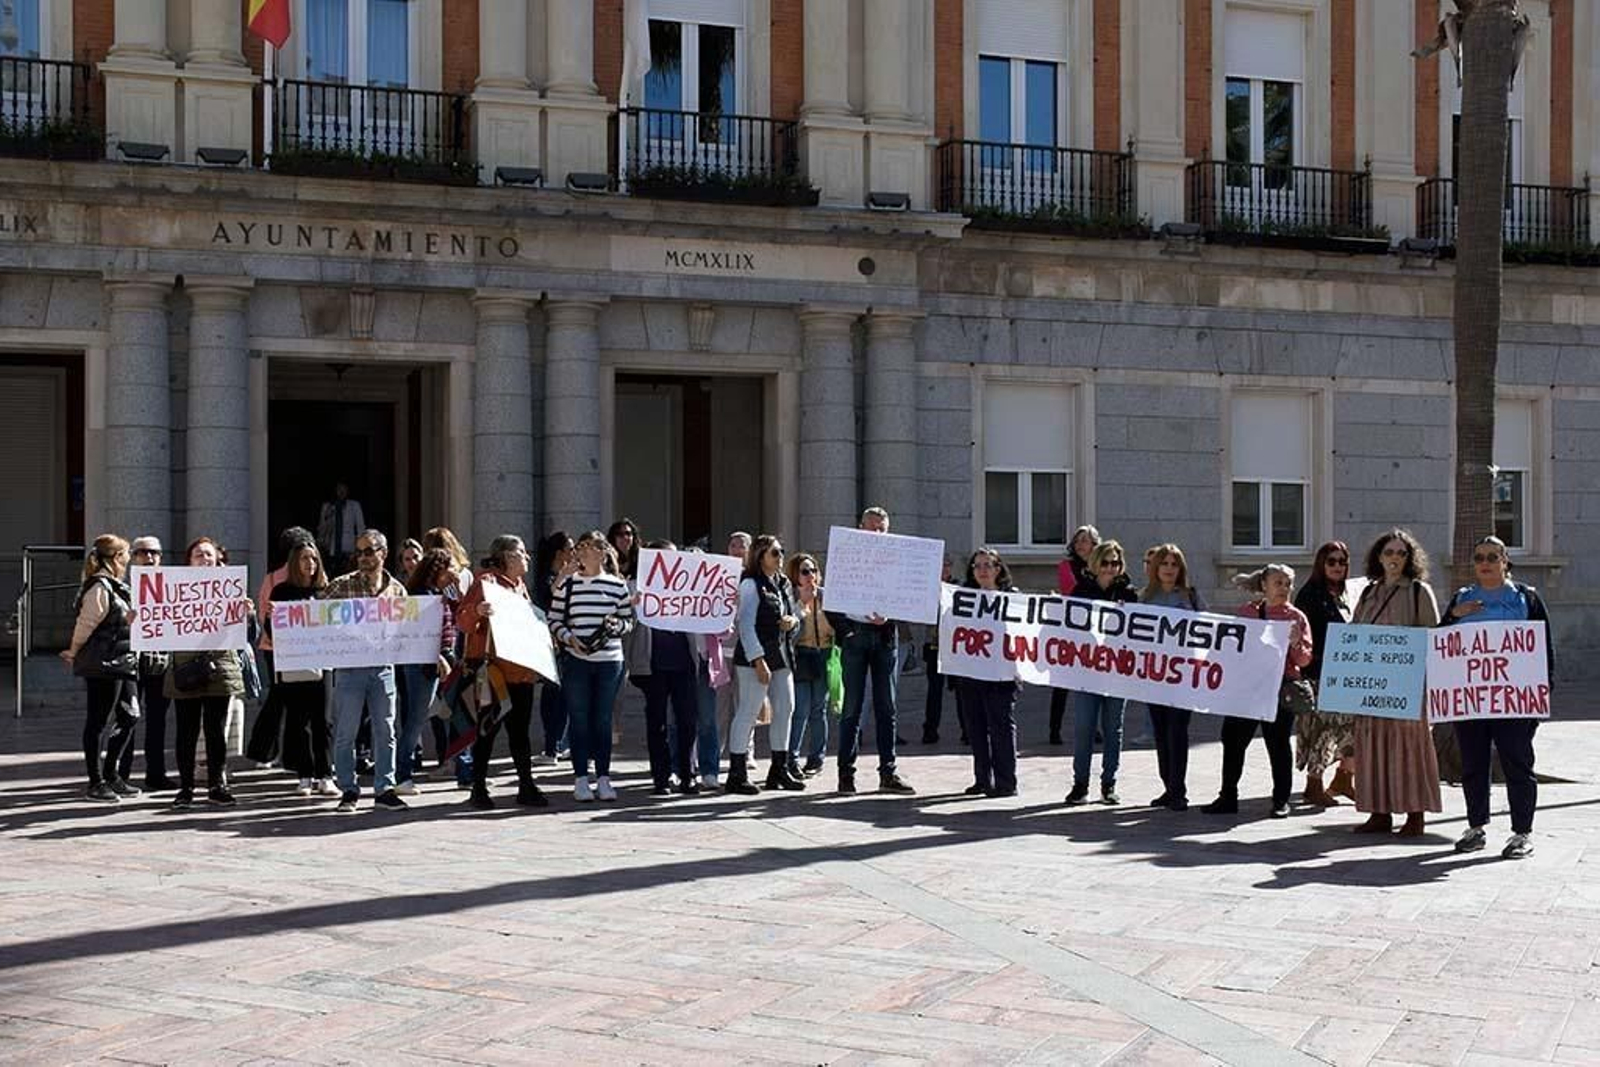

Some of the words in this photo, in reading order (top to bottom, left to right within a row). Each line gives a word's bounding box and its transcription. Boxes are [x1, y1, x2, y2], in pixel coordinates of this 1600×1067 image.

[211, 221, 520, 259] AYUNTAMIENTO
[665, 249, 755, 270] MCMXLIX
[139, 572, 243, 605] NUESTROS
[690, 560, 739, 598] MÁS
[140, 600, 224, 622] DERECHOS
[223, 601, 246, 626] NO
[273, 597, 420, 629] EMLICODEMSA
[643, 593, 735, 618] DESPIDOS
[141, 623, 163, 639] SE
[173, 617, 219, 636] TOCAN
[950, 589, 1247, 654] EMLICODEMSA
[1368, 633, 1410, 646] NUESTROS
[1470, 628, 1496, 655] AL
[1499, 626, 1535, 654] AÑO
[951, 626, 995, 659] POR
[1002, 633, 1039, 664] UN
[1045, 636, 1136, 677] CONVENIO
[1136, 650, 1224, 690] JUSTO
[1363, 652, 1374, 663] DE
[1380, 652, 1415, 665] REPOSO
[1466, 656, 1510, 683] POR
[1342, 676, 1388, 690] DERECHO
[1429, 688, 1448, 718] NO
[1453, 684, 1550, 717] ENFERMAR
